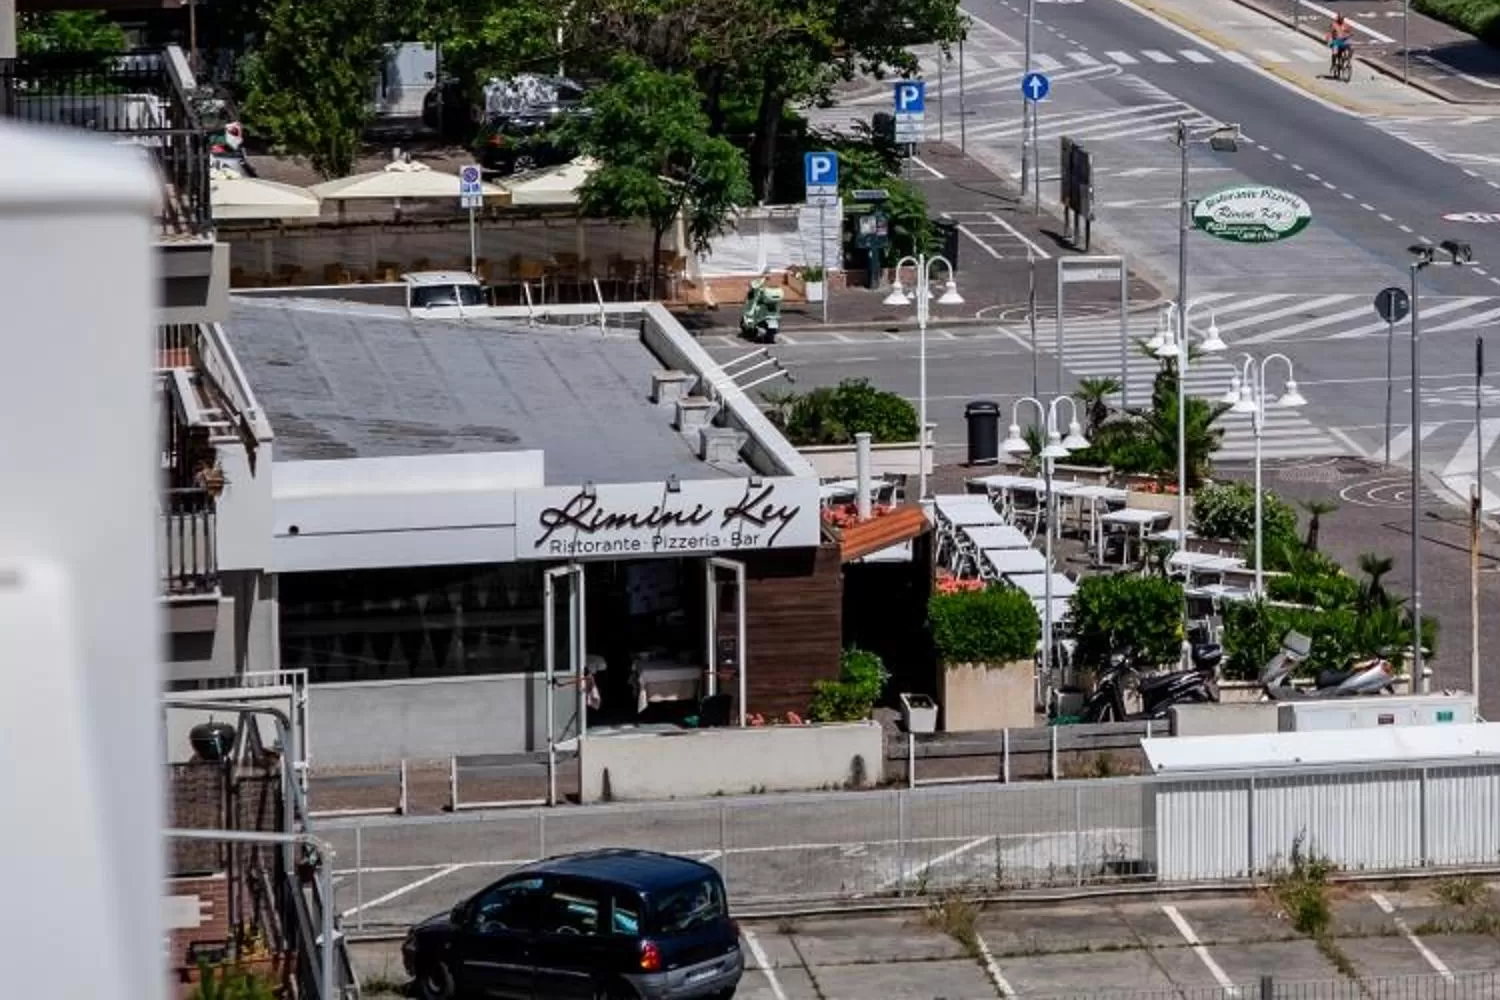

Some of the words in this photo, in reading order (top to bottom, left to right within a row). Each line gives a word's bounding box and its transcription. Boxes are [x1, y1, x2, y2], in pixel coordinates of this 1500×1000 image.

[901, 86, 918, 109] P
[811, 156, 831, 181] P
[534, 490, 713, 548] Rimini
[720, 484, 801, 547] Key
[550, 536, 641, 554] Ristorante
[653, 533, 720, 552] Pizzeria
[731, 531, 760, 548] Bar
